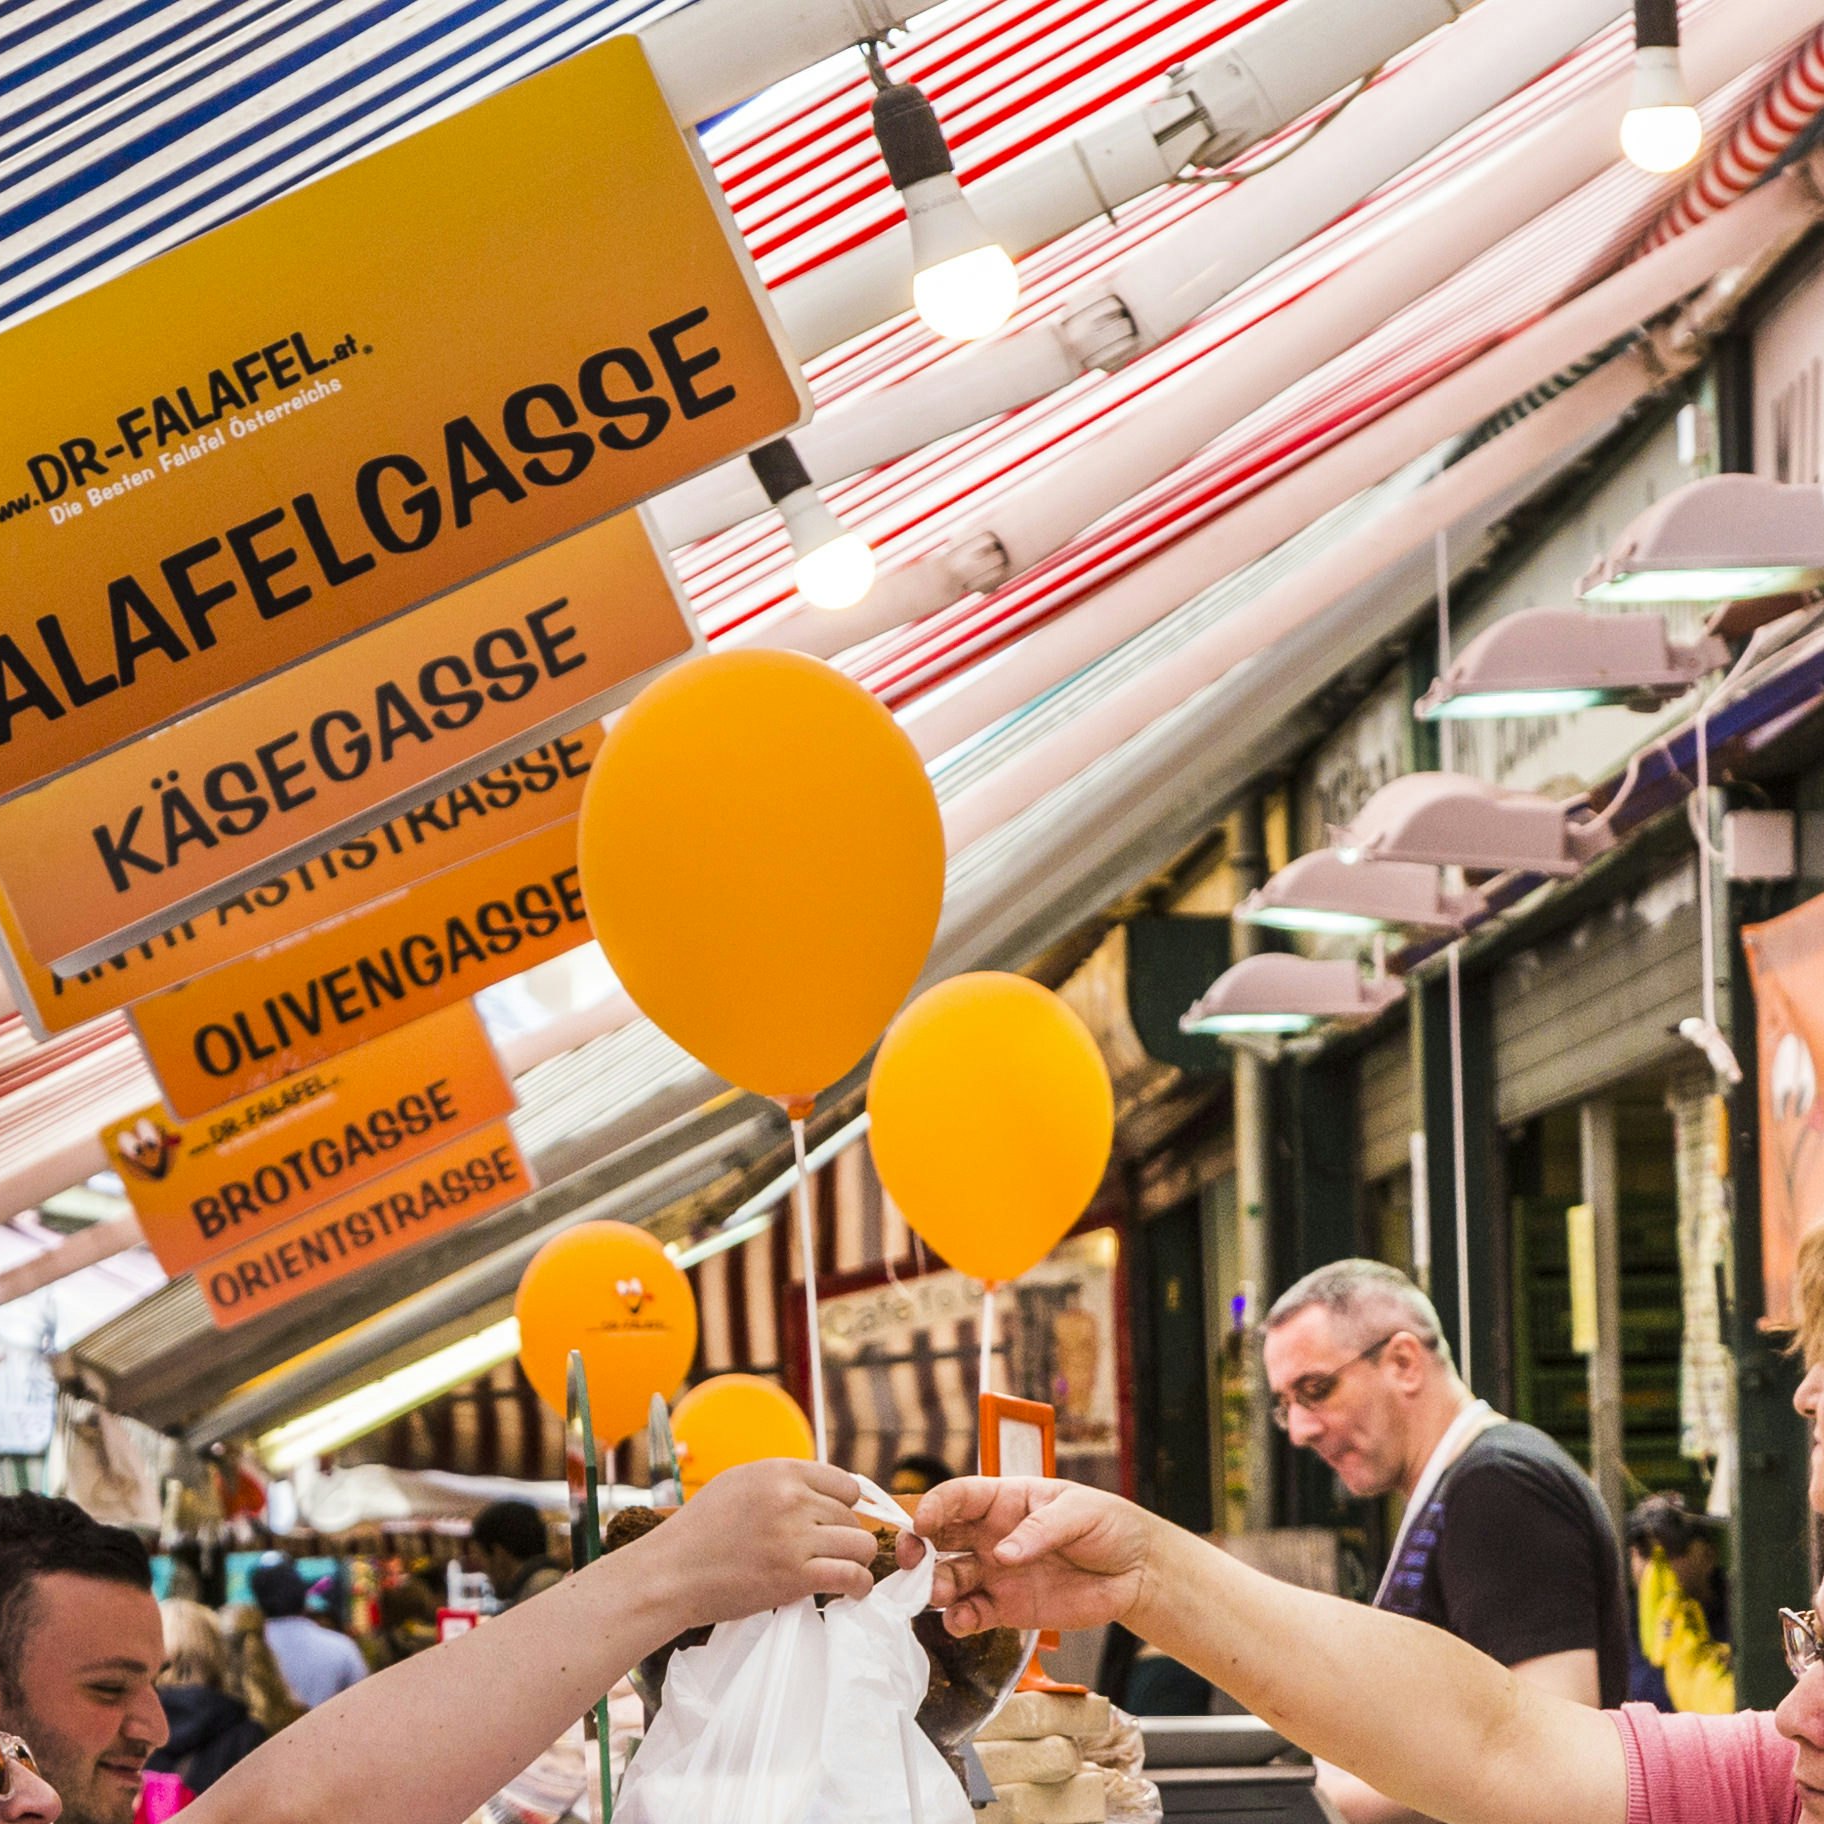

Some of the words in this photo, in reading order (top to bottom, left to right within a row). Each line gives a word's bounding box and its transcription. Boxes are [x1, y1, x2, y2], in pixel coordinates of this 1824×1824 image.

[49, 499, 84, 525] Die
[86, 466, 155, 508] Besten
[159, 428, 225, 473] Falafel
[229, 377, 342, 438] Österreichs
[92, 597, 587, 893] KÄSEGASSE
[193, 865, 589, 1077] OLIVENGASSE
[190, 1082, 459, 1239] BROTGASSE
[210, 1144, 519, 1310] ORIENTSTRASSE
